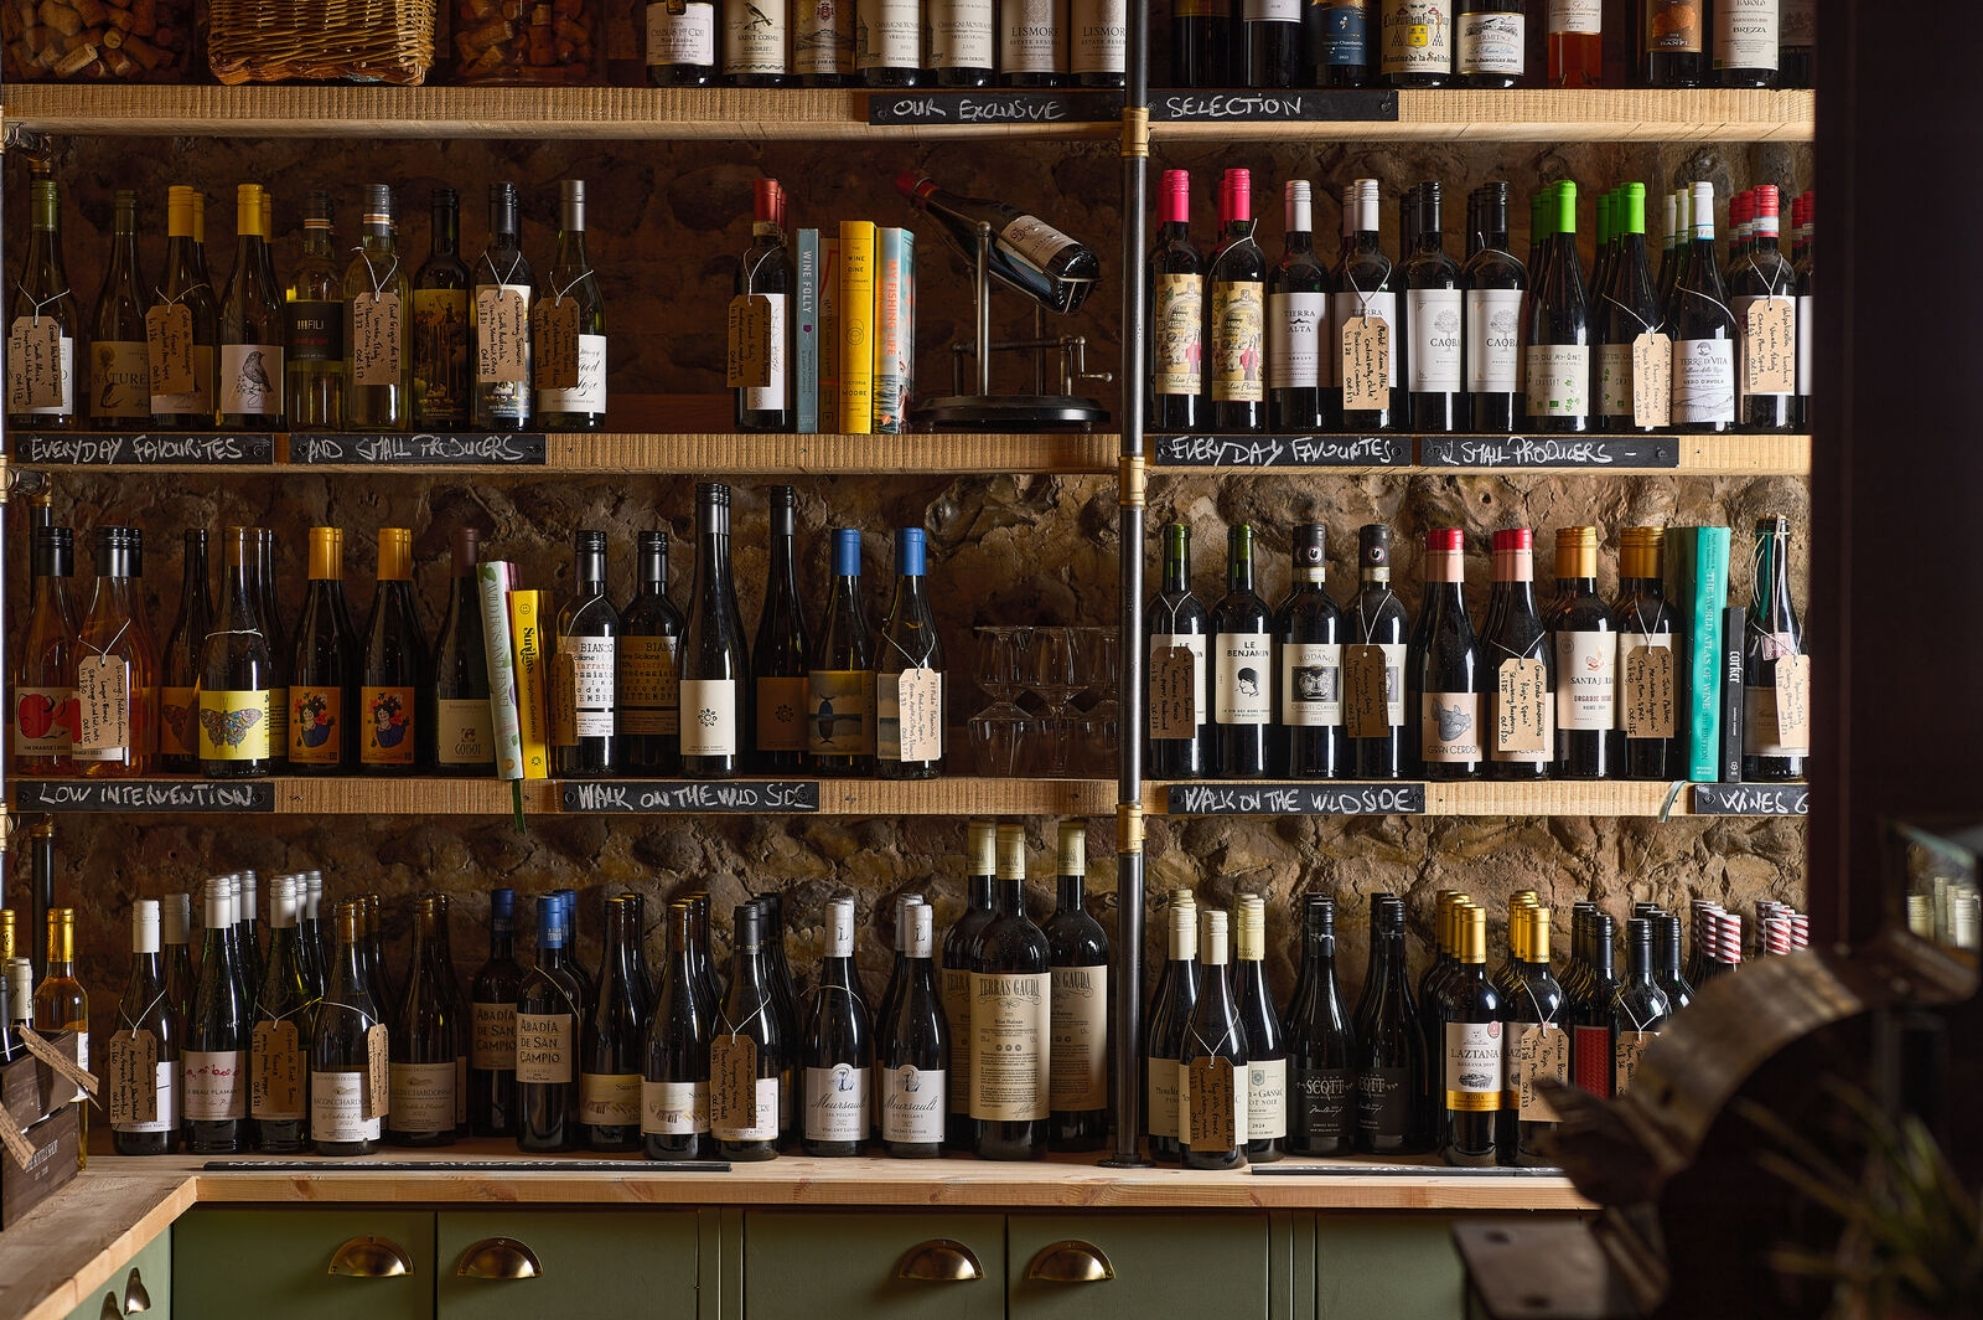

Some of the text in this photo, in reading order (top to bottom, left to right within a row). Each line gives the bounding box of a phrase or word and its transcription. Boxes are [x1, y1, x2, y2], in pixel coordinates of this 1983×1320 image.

[893, 99, 947, 116] OUR
[802, 250, 813, 313] WINE FOLLY
[887, 260, 897, 357] MY FISHING LIFE
[1283, 309, 1316, 318] TIERRA
[1486, 338, 1520, 347] CAOBA
[30, 434, 243, 464] EVERYDAY FAVOURITES
[307, 433, 524, 463] AND SMALL PRODUCERS
[1171, 436, 1393, 466] EVERYDAY FAVOURITES
[1461, 441, 1511, 466] SMALL
[1507, 436, 1613, 464] PRODUCERS
[1705, 572, 1715, 593] THE
[1703, 596, 1715, 631] WORLD
[486, 583, 509, 706] WILD FIGS AND FENNEL
[1702, 633, 1714, 664] ATLAS
[1703, 668, 1713, 680] OF
[1727, 650, 1742, 683] corker
[1701, 684, 1712, 709] WINE
[1428, 745, 1477, 754] GRAN CERDO
[39, 781, 253, 807] LOW INTERVENTION
[577, 783, 815, 811] WALK ON THE WILD SIDE
[1183, 786, 1416, 813] WALK ON THE WILD SIDE
[1718, 787, 1788, 812] WINES
[521, 1035, 559, 1048] DE SAN
[1450, 1048, 1500, 1059] LAZTANA
[520, 1051, 562, 1064] CAMPIO
